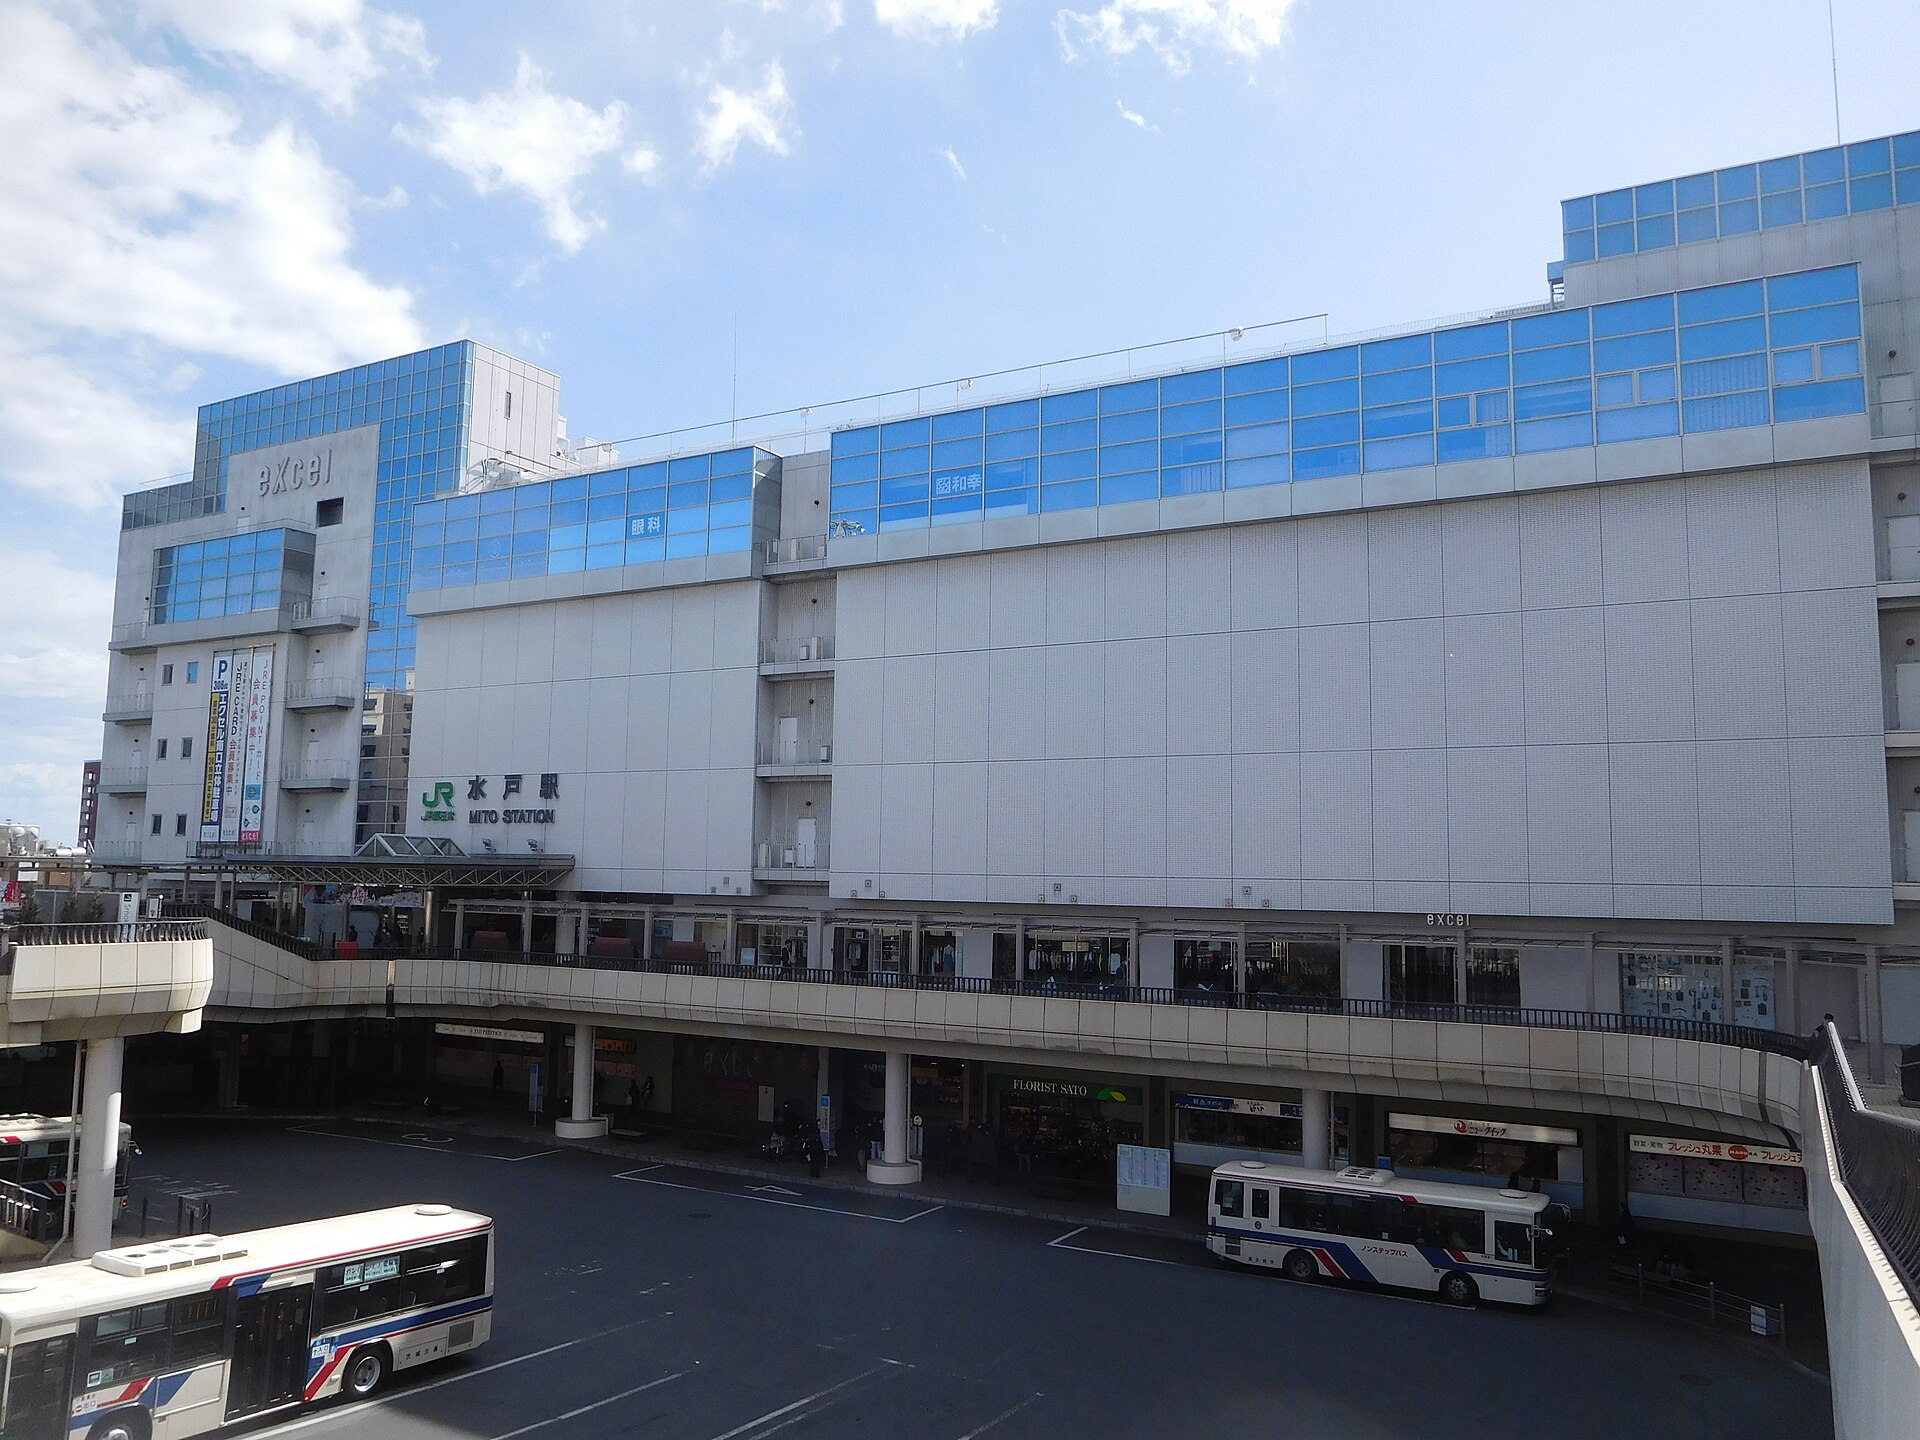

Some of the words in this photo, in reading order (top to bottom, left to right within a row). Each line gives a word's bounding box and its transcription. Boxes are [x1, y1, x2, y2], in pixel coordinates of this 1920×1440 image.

[631, 515, 661, 536] 眼科
[218, 659, 228, 680] P
[234, 661, 243, 693] JRE
[230, 696, 240, 736] CARD
[257, 695, 266, 744] POINT
[421, 781, 455, 808] JR
[467, 773, 560, 801] 水戸駅
[468, 809, 499, 824] MITO
[502, 809, 557, 824] STATION
[1012, 1078, 1058, 1094] FLORIST
[1059, 1082, 1088, 1097] SATO
[1361, 1245, 1409, 1258] ノンステップバス
